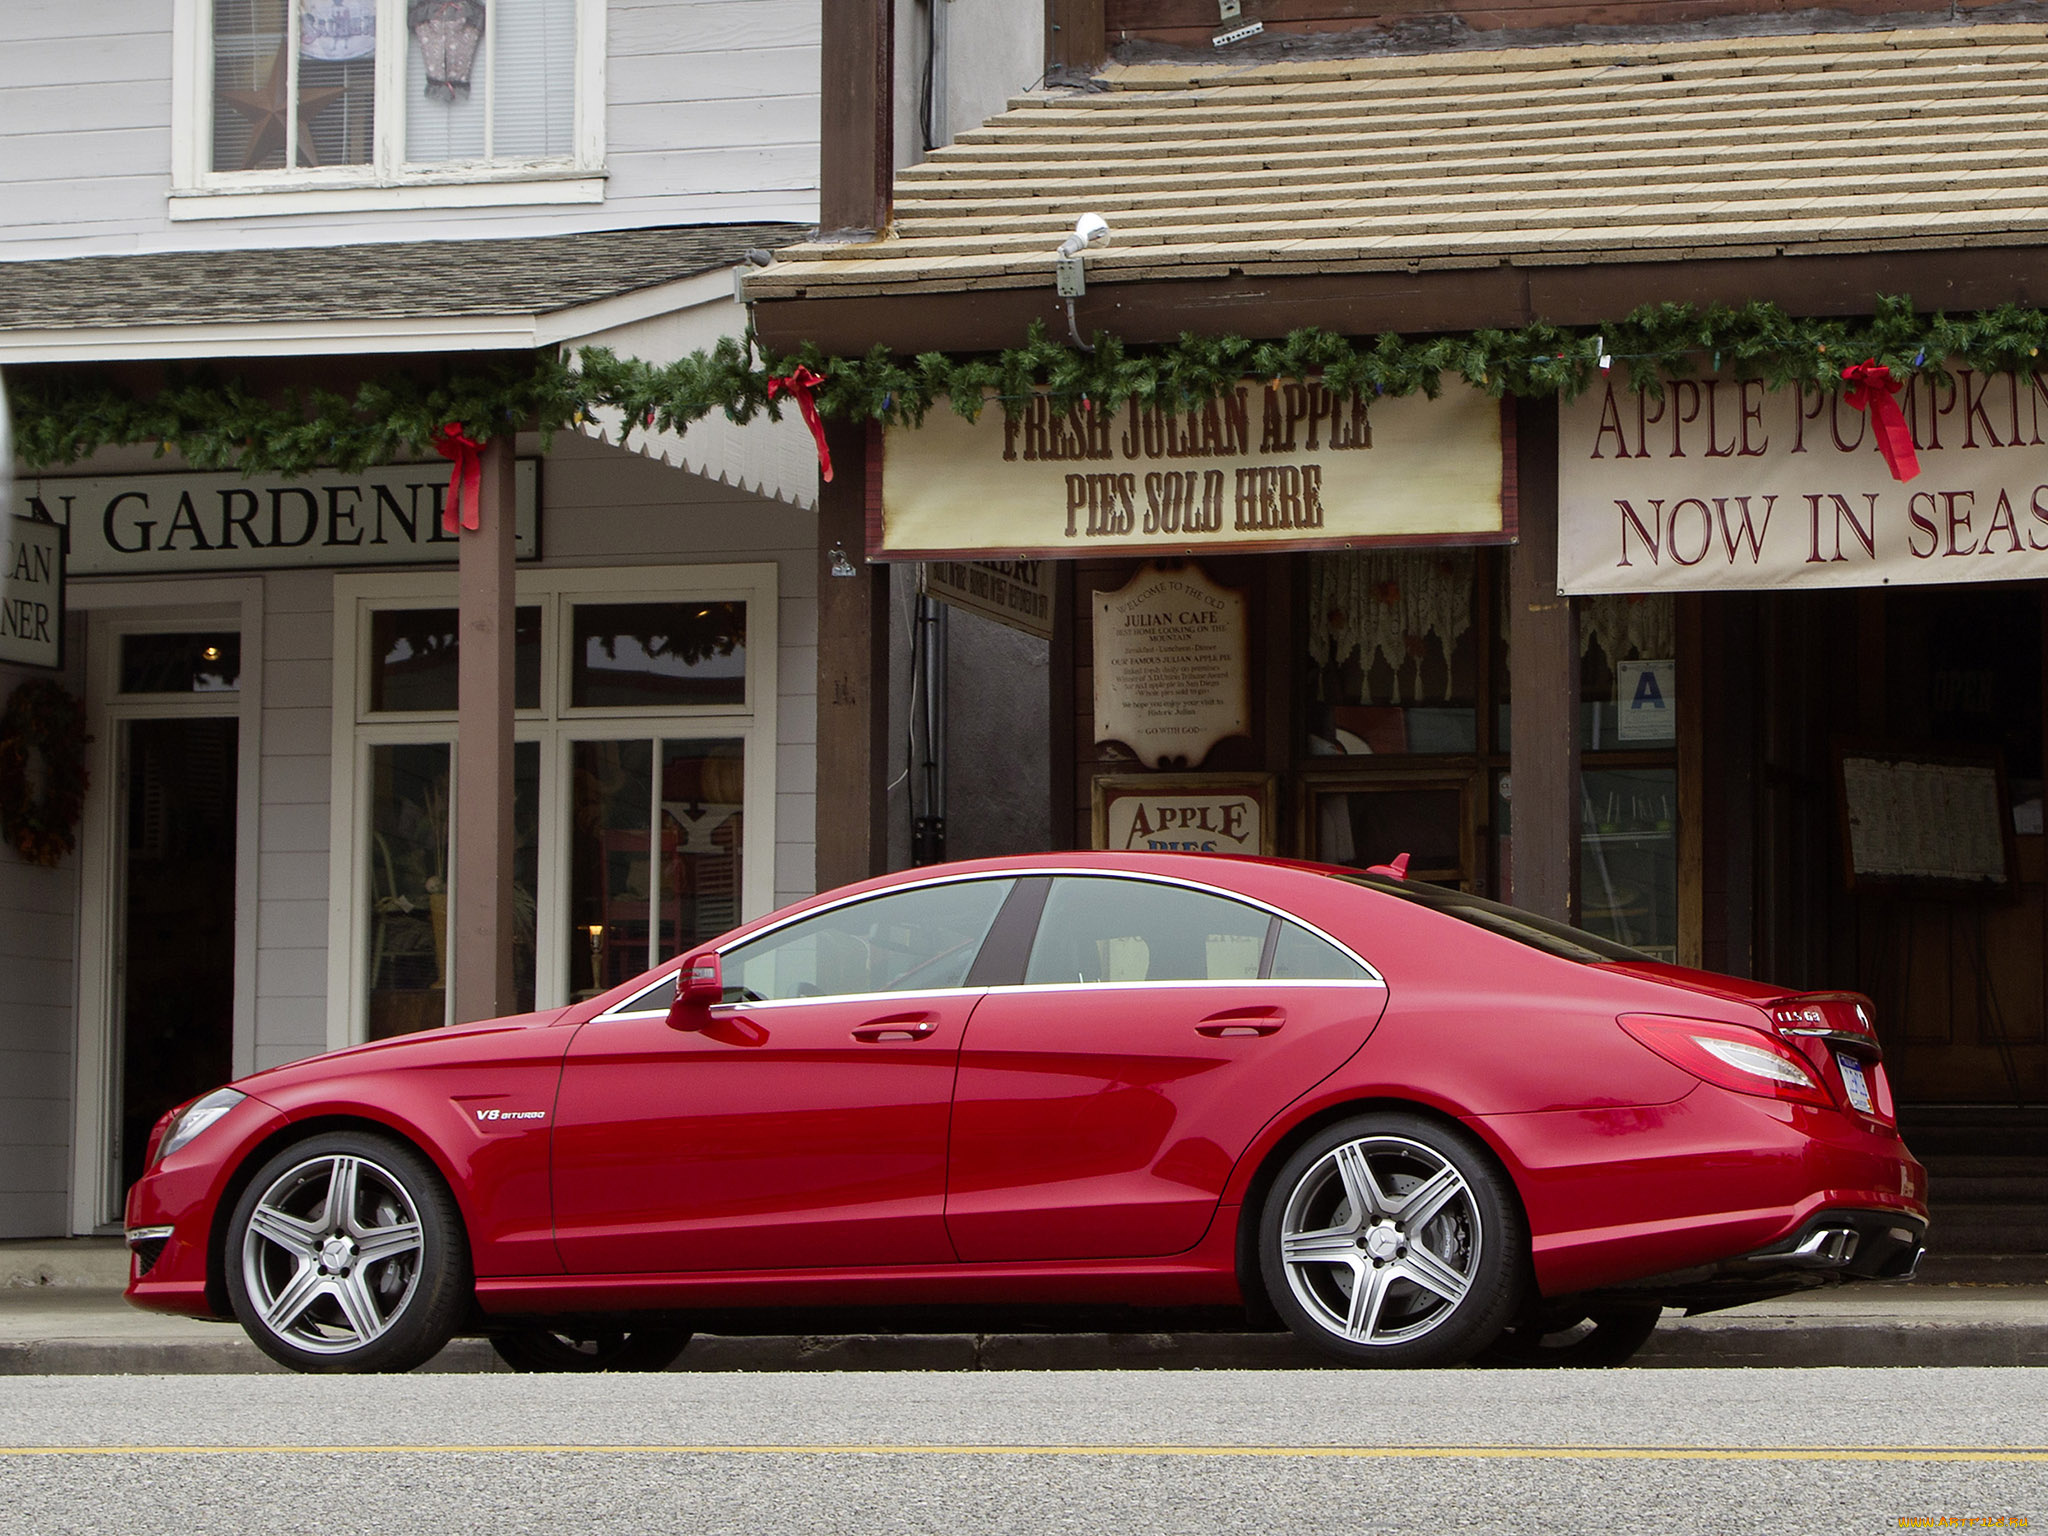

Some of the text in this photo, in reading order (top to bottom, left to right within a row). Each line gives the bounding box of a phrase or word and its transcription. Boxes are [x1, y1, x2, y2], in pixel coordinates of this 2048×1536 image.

[1002, 381, 1373, 461] FRESH JULIAN APPLE
[1590, 378, 1769, 459] APPLE
[102, 482, 522, 553] GARDENE
[1064, 464, 1325, 537] PIES SOLD HERE
[1613, 495, 1778, 567] NOW
[1803, 492, 1879, 563] IN
[1116, 581, 1225, 614] WELCOME TO THE OLD
[1124, 611, 1218, 627] JULIAN CAFE
[1158, 626, 1196, 634] COOKING
[1197, 625, 1208, 633] ON
[1130, 657, 1161, 665] FAMOUS
[1163, 656, 1191, 664] JULIAN
[1631, 672, 1665, 709] A
[1181, 726, 1200, 735] GOD
[1126, 803, 1249, 849] APPLE
[476, 1109, 546, 1120] V8 BITURBO
